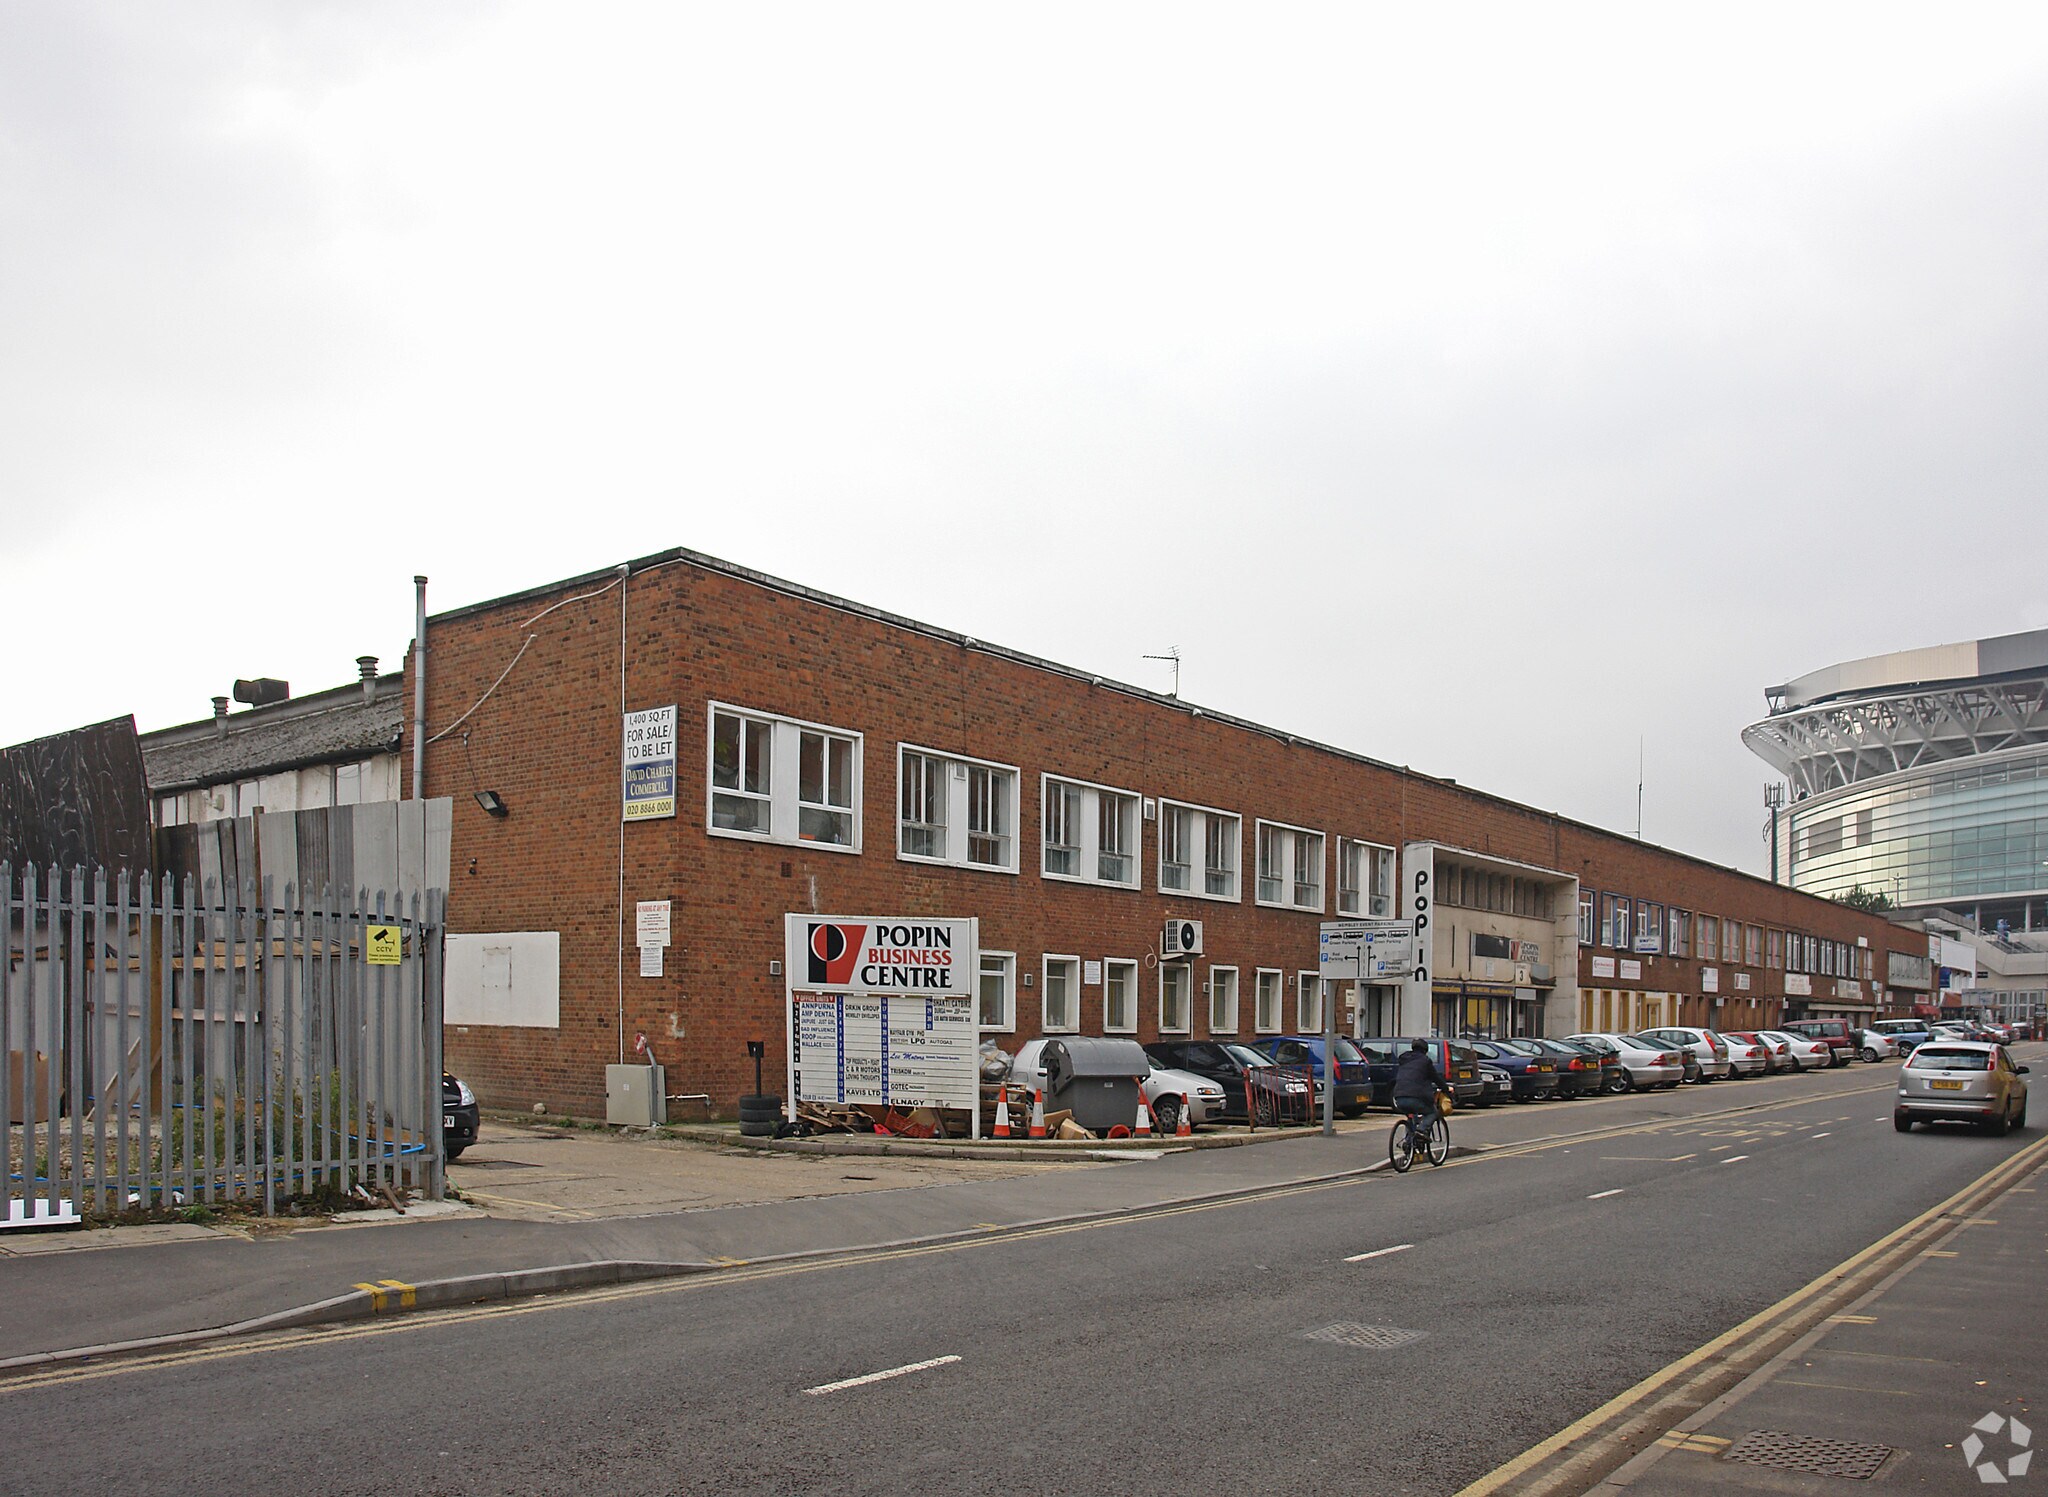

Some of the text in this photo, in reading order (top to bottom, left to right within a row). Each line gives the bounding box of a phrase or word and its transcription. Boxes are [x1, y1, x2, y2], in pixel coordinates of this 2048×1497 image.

[649, 710, 671, 722] SQ.FT
[628, 724, 672, 742] FOR SALE/
[628, 742, 672, 758] TO BE LET
[627, 766, 672, 782] DAVID CHARLES
[630, 781, 668, 796] COMMERCIAL
[627, 801, 671, 815] 020 8866 0001
[876, 925, 951, 948] POPIN
[868, 948, 952, 965] BUSINESS
[861, 966, 952, 988] CENTRE
[1520, 970, 1524, 981] 3
